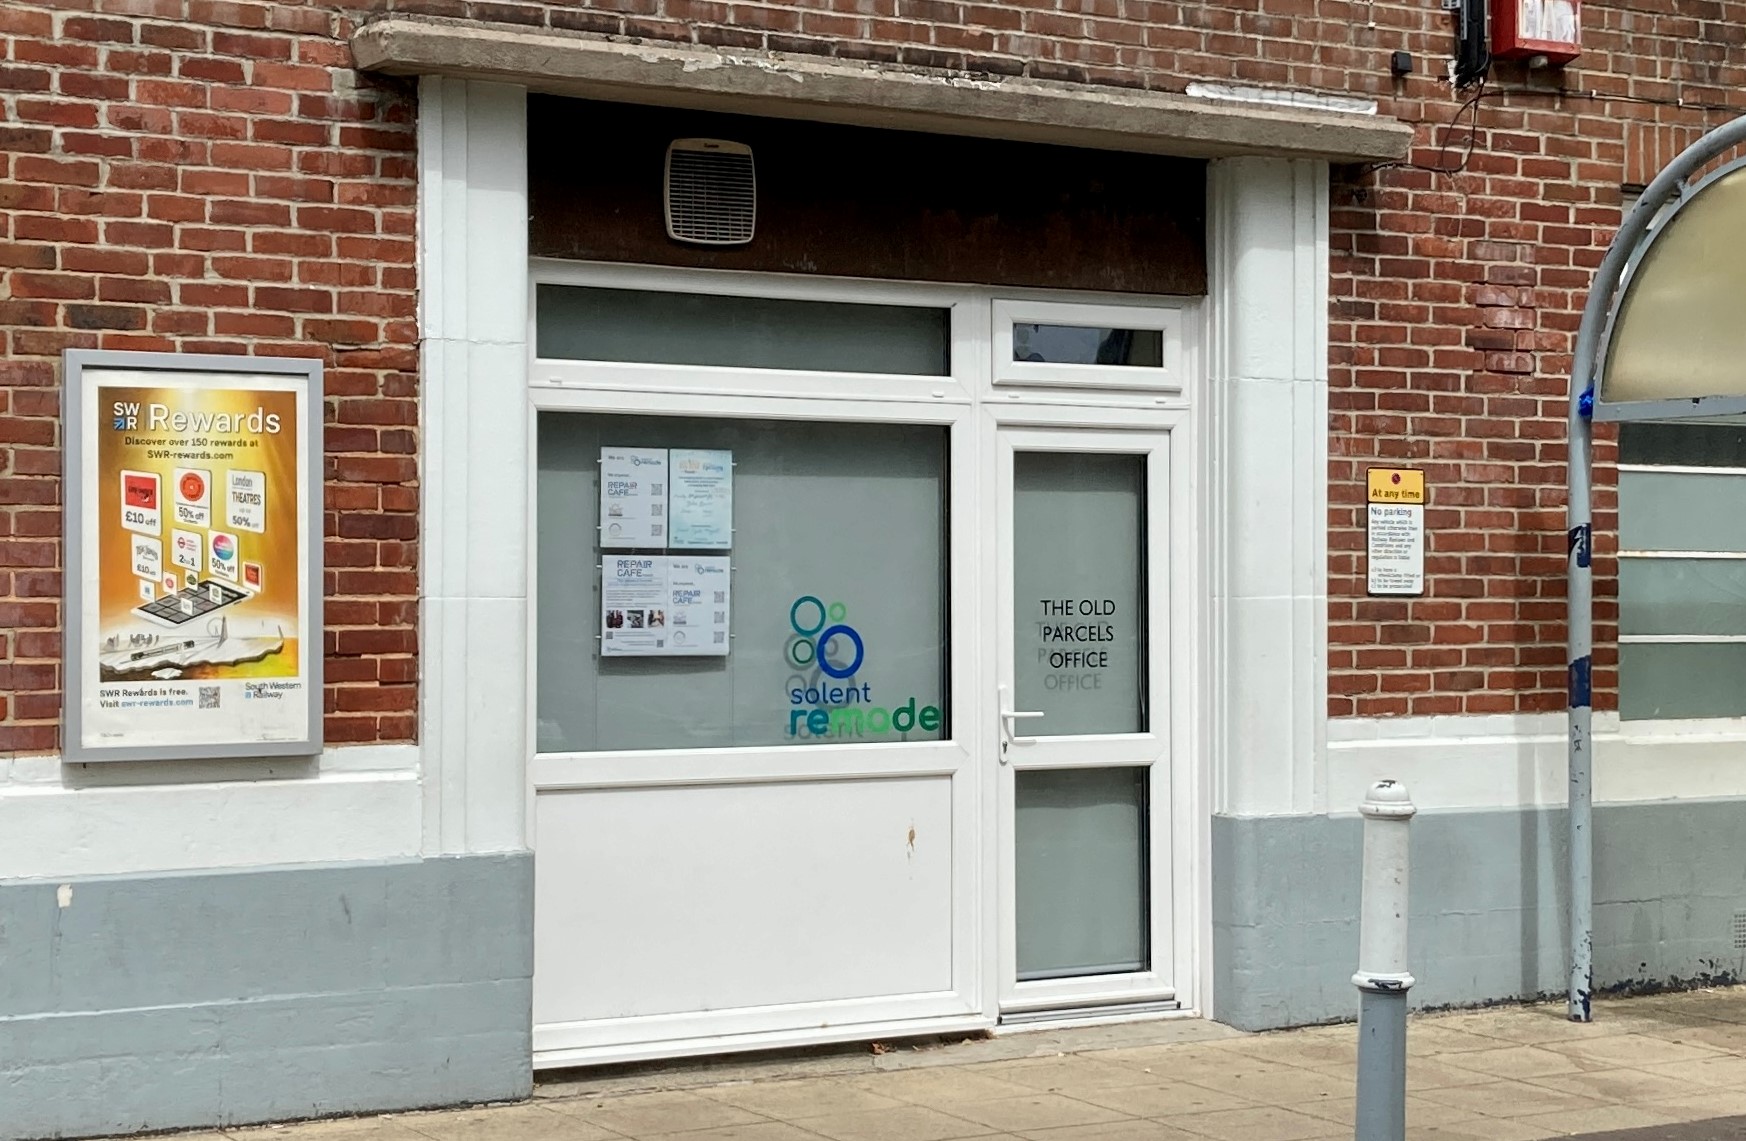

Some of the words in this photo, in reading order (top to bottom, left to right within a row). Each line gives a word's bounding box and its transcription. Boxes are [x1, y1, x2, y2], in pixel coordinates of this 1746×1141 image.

[150, 403, 282, 434] Rewards
[124, 436, 166, 446] Discover
[169, 438, 188, 446] over
[192, 438, 208, 446] 150
[210, 438, 247, 448] rewards
[249, 439, 258, 448] at
[147, 450, 234, 460] SWR-rewards.com
[232, 491, 261, 506] THEATRES
[1372, 488, 1382, 498] At
[1384, 490, 1399, 500] any
[1402, 489, 1420, 499] time
[125, 511, 144, 524] £10
[1371, 507, 1382, 516] No
[1384, 508, 1412, 518] parking
[617, 560, 652, 568] REPAIR
[617, 569, 642, 577] CAFE
[1040, 600, 1074, 615] THE
[1079, 600, 1116, 615] OLD
[1043, 626, 1114, 642] PARCELS
[1050, 652, 1108, 668] OFFICE
[100, 689, 120, 698] SWR
[122, 688, 158, 697] Rewards
[168, 687, 188, 696] free.
[245, 682, 268, 691] South
[269, 682, 301, 690] Western
[253, 691, 283, 699] Railway
[790, 682, 872, 704] solent
[100, 700, 120, 708] Visit
[121, 698, 194, 708] swr-rewards.com
